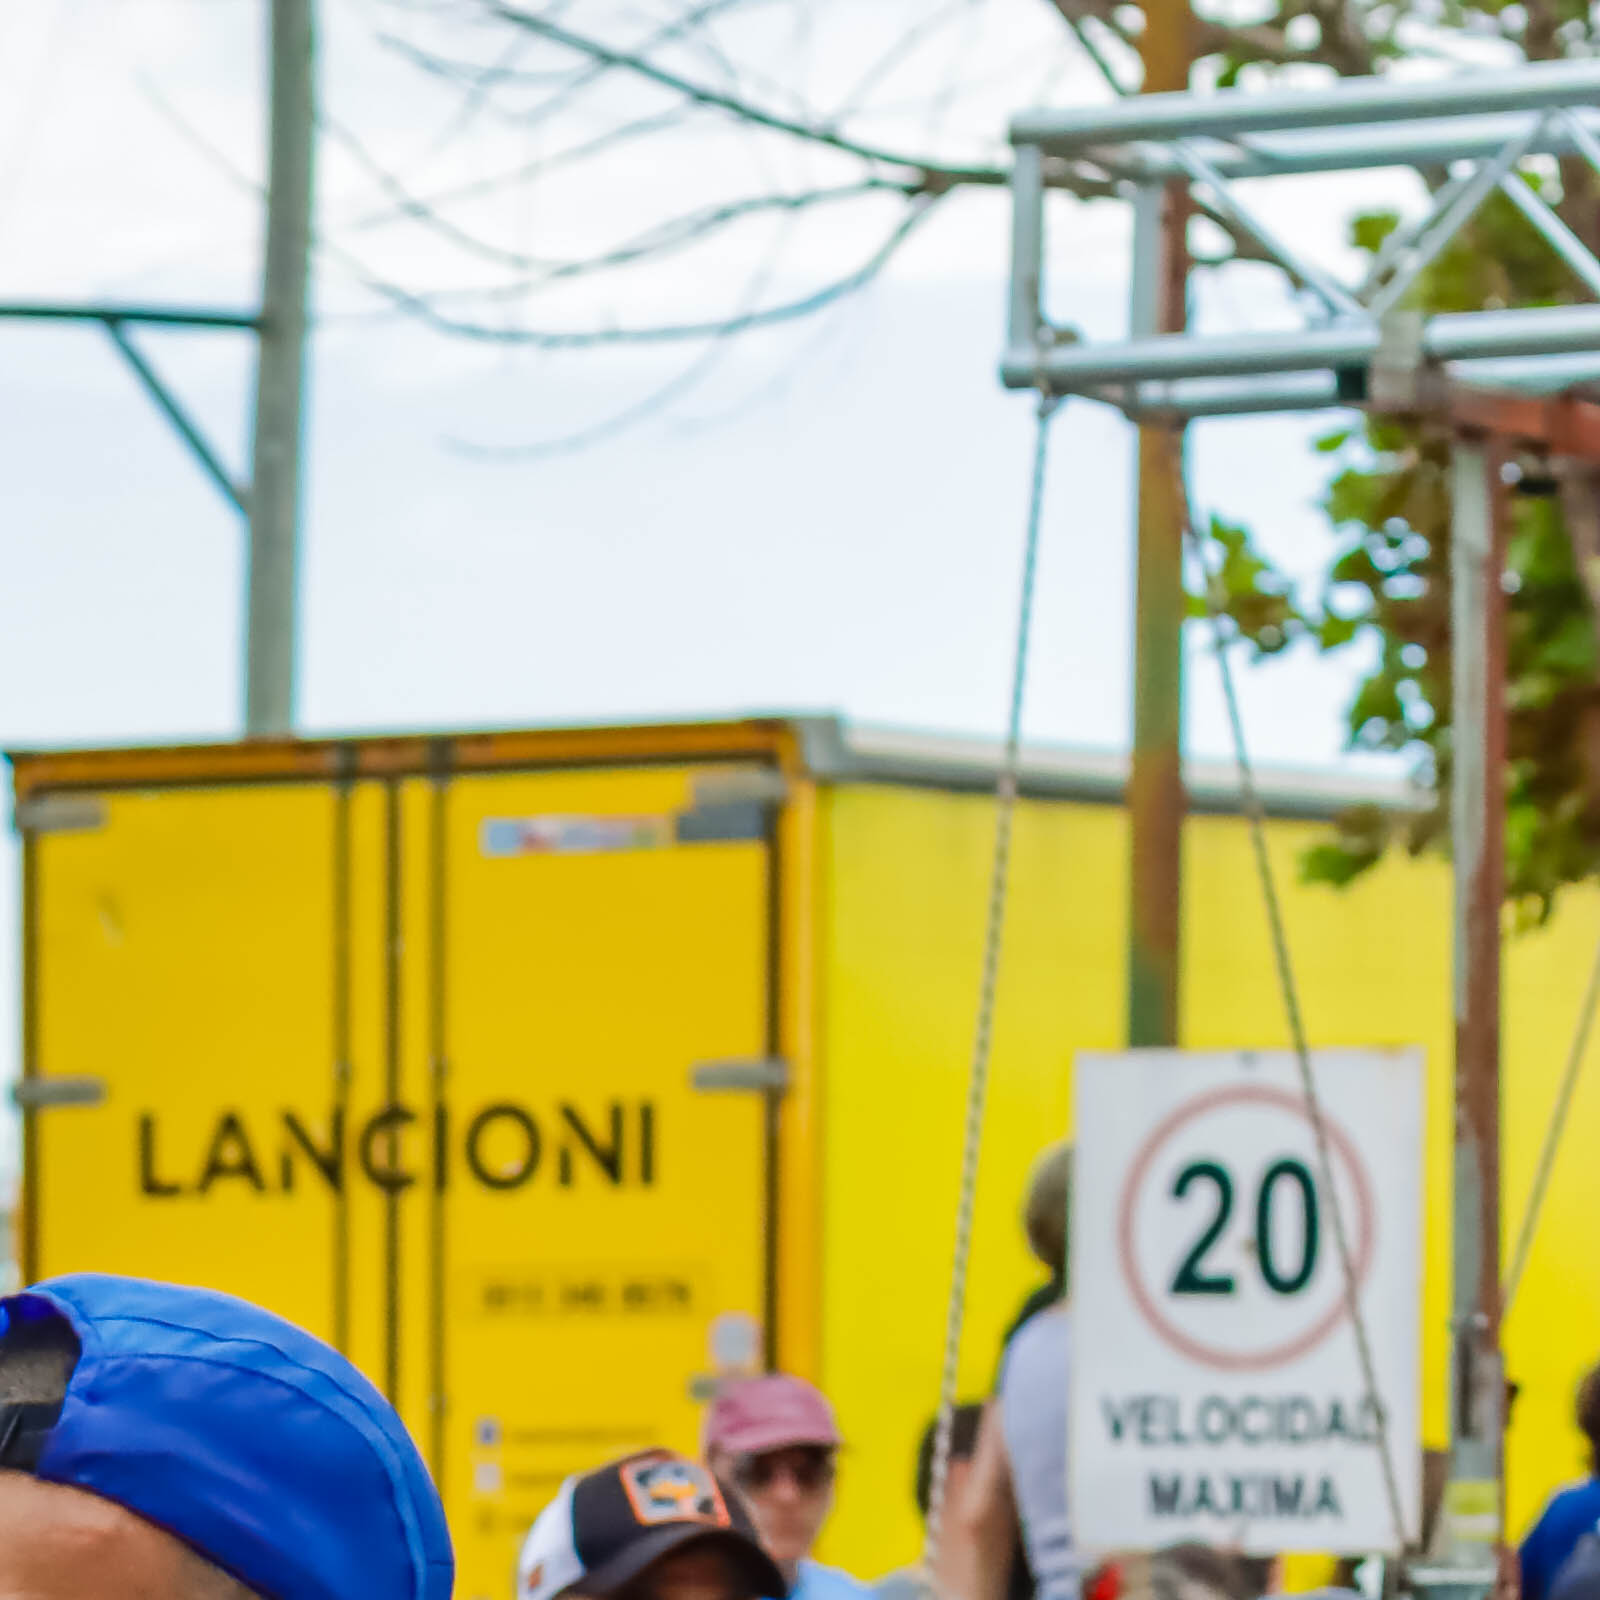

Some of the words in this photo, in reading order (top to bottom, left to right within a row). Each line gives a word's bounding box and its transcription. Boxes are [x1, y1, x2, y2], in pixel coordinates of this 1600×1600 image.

[137, 1104, 655, 1198] LANCIONI
[1172, 1160, 1319, 1295] 20
[1101, 1396, 1386, 1446] VELOCIDAD
[1149, 1473, 1341, 1519] MAXIMA
